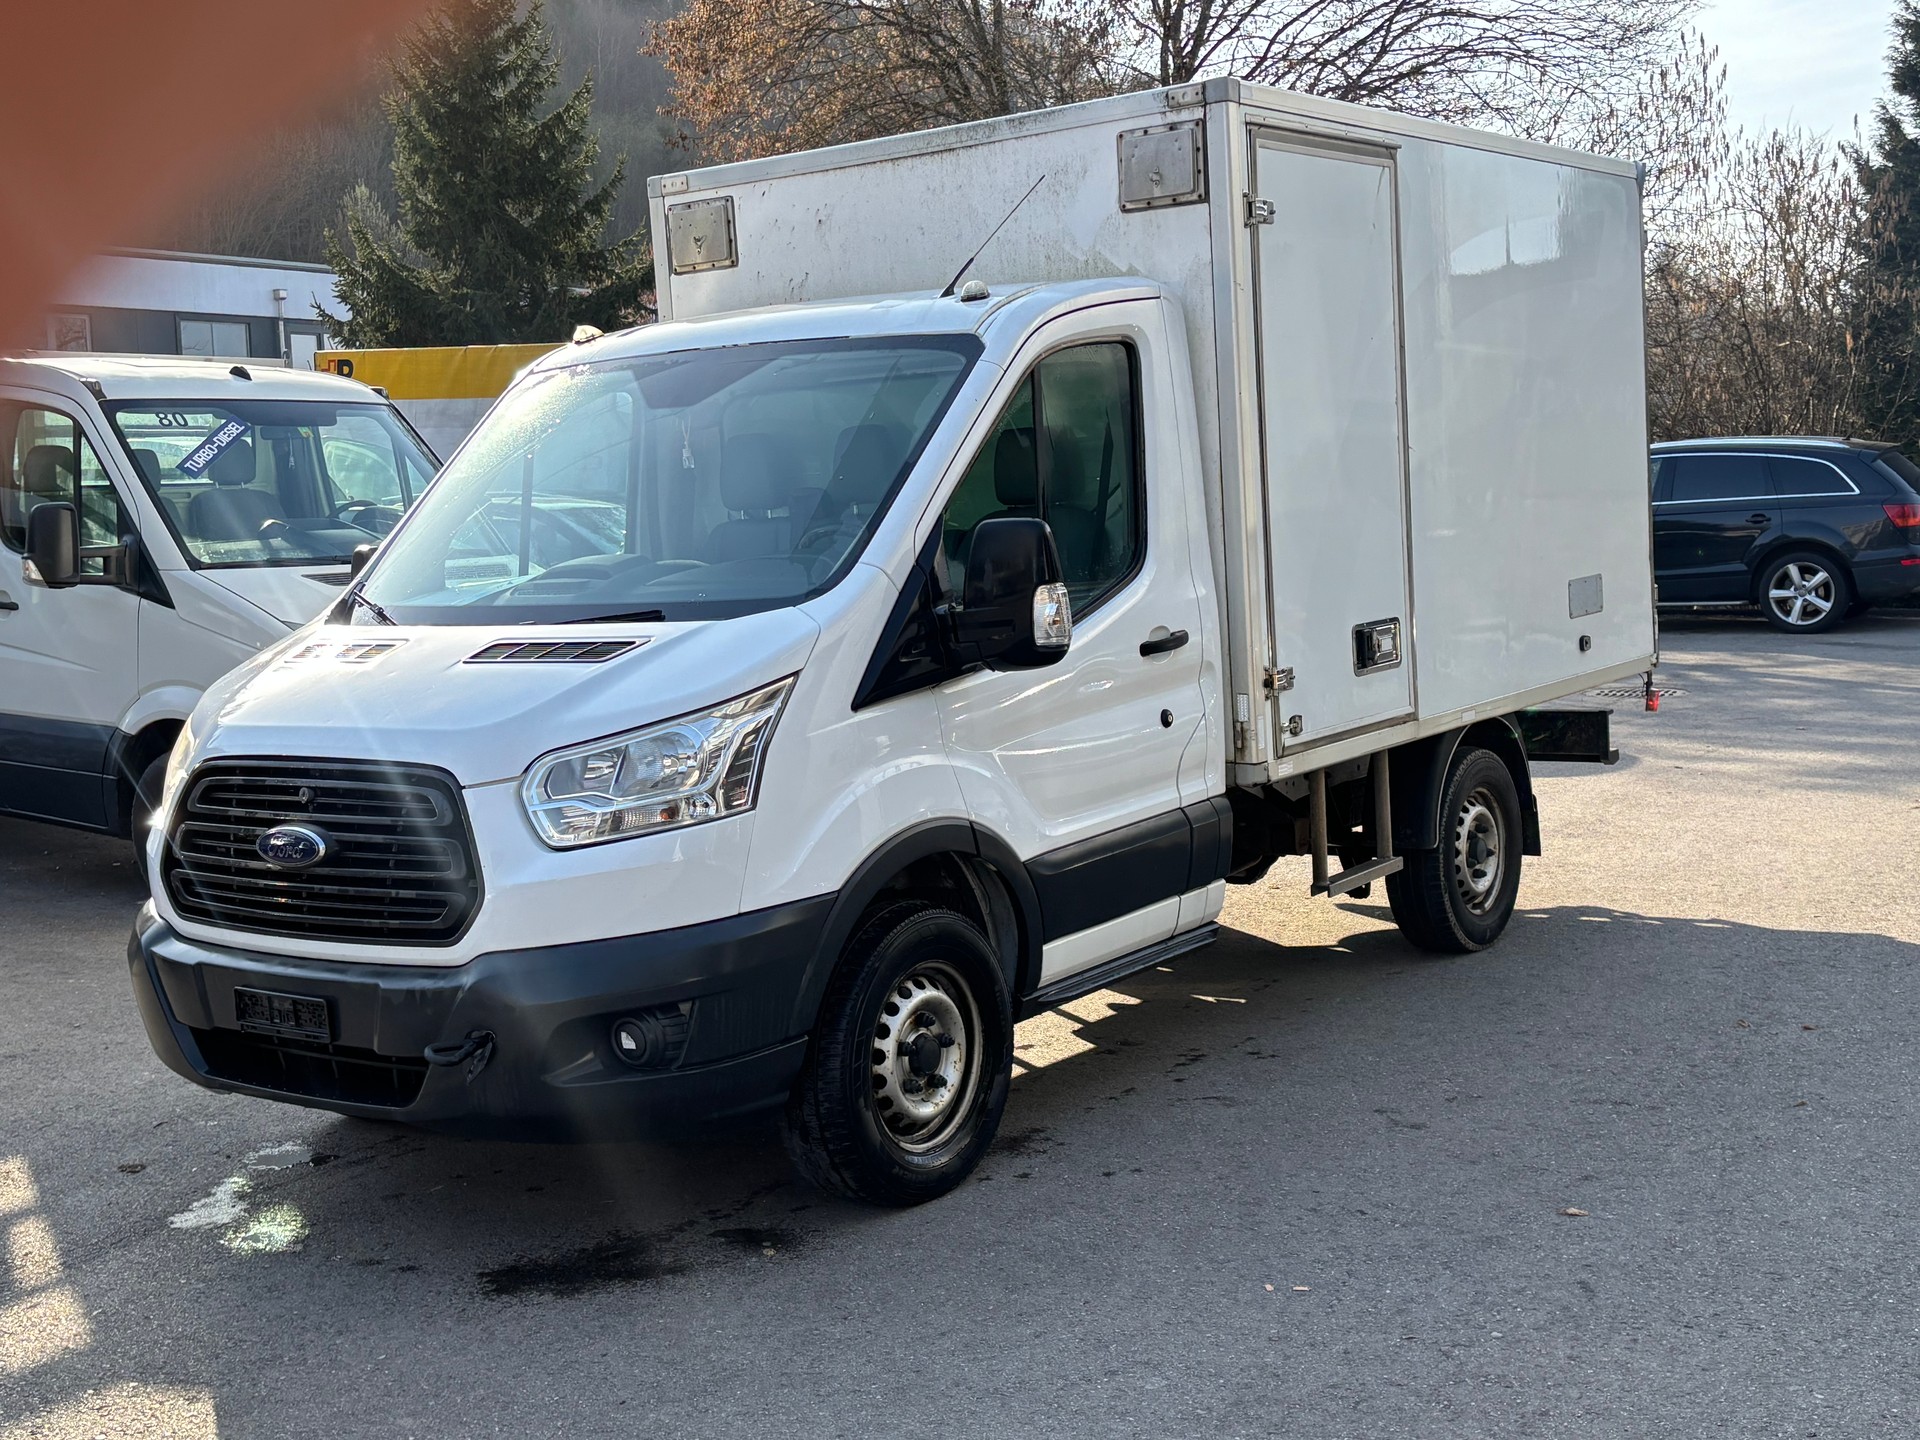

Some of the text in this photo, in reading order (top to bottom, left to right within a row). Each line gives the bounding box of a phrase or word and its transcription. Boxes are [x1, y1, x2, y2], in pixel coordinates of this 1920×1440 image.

[155, 412, 188, 427] 80
[184, 421, 245, 472] TURBO-DIESEL
[267, 834, 311, 858] Ford
